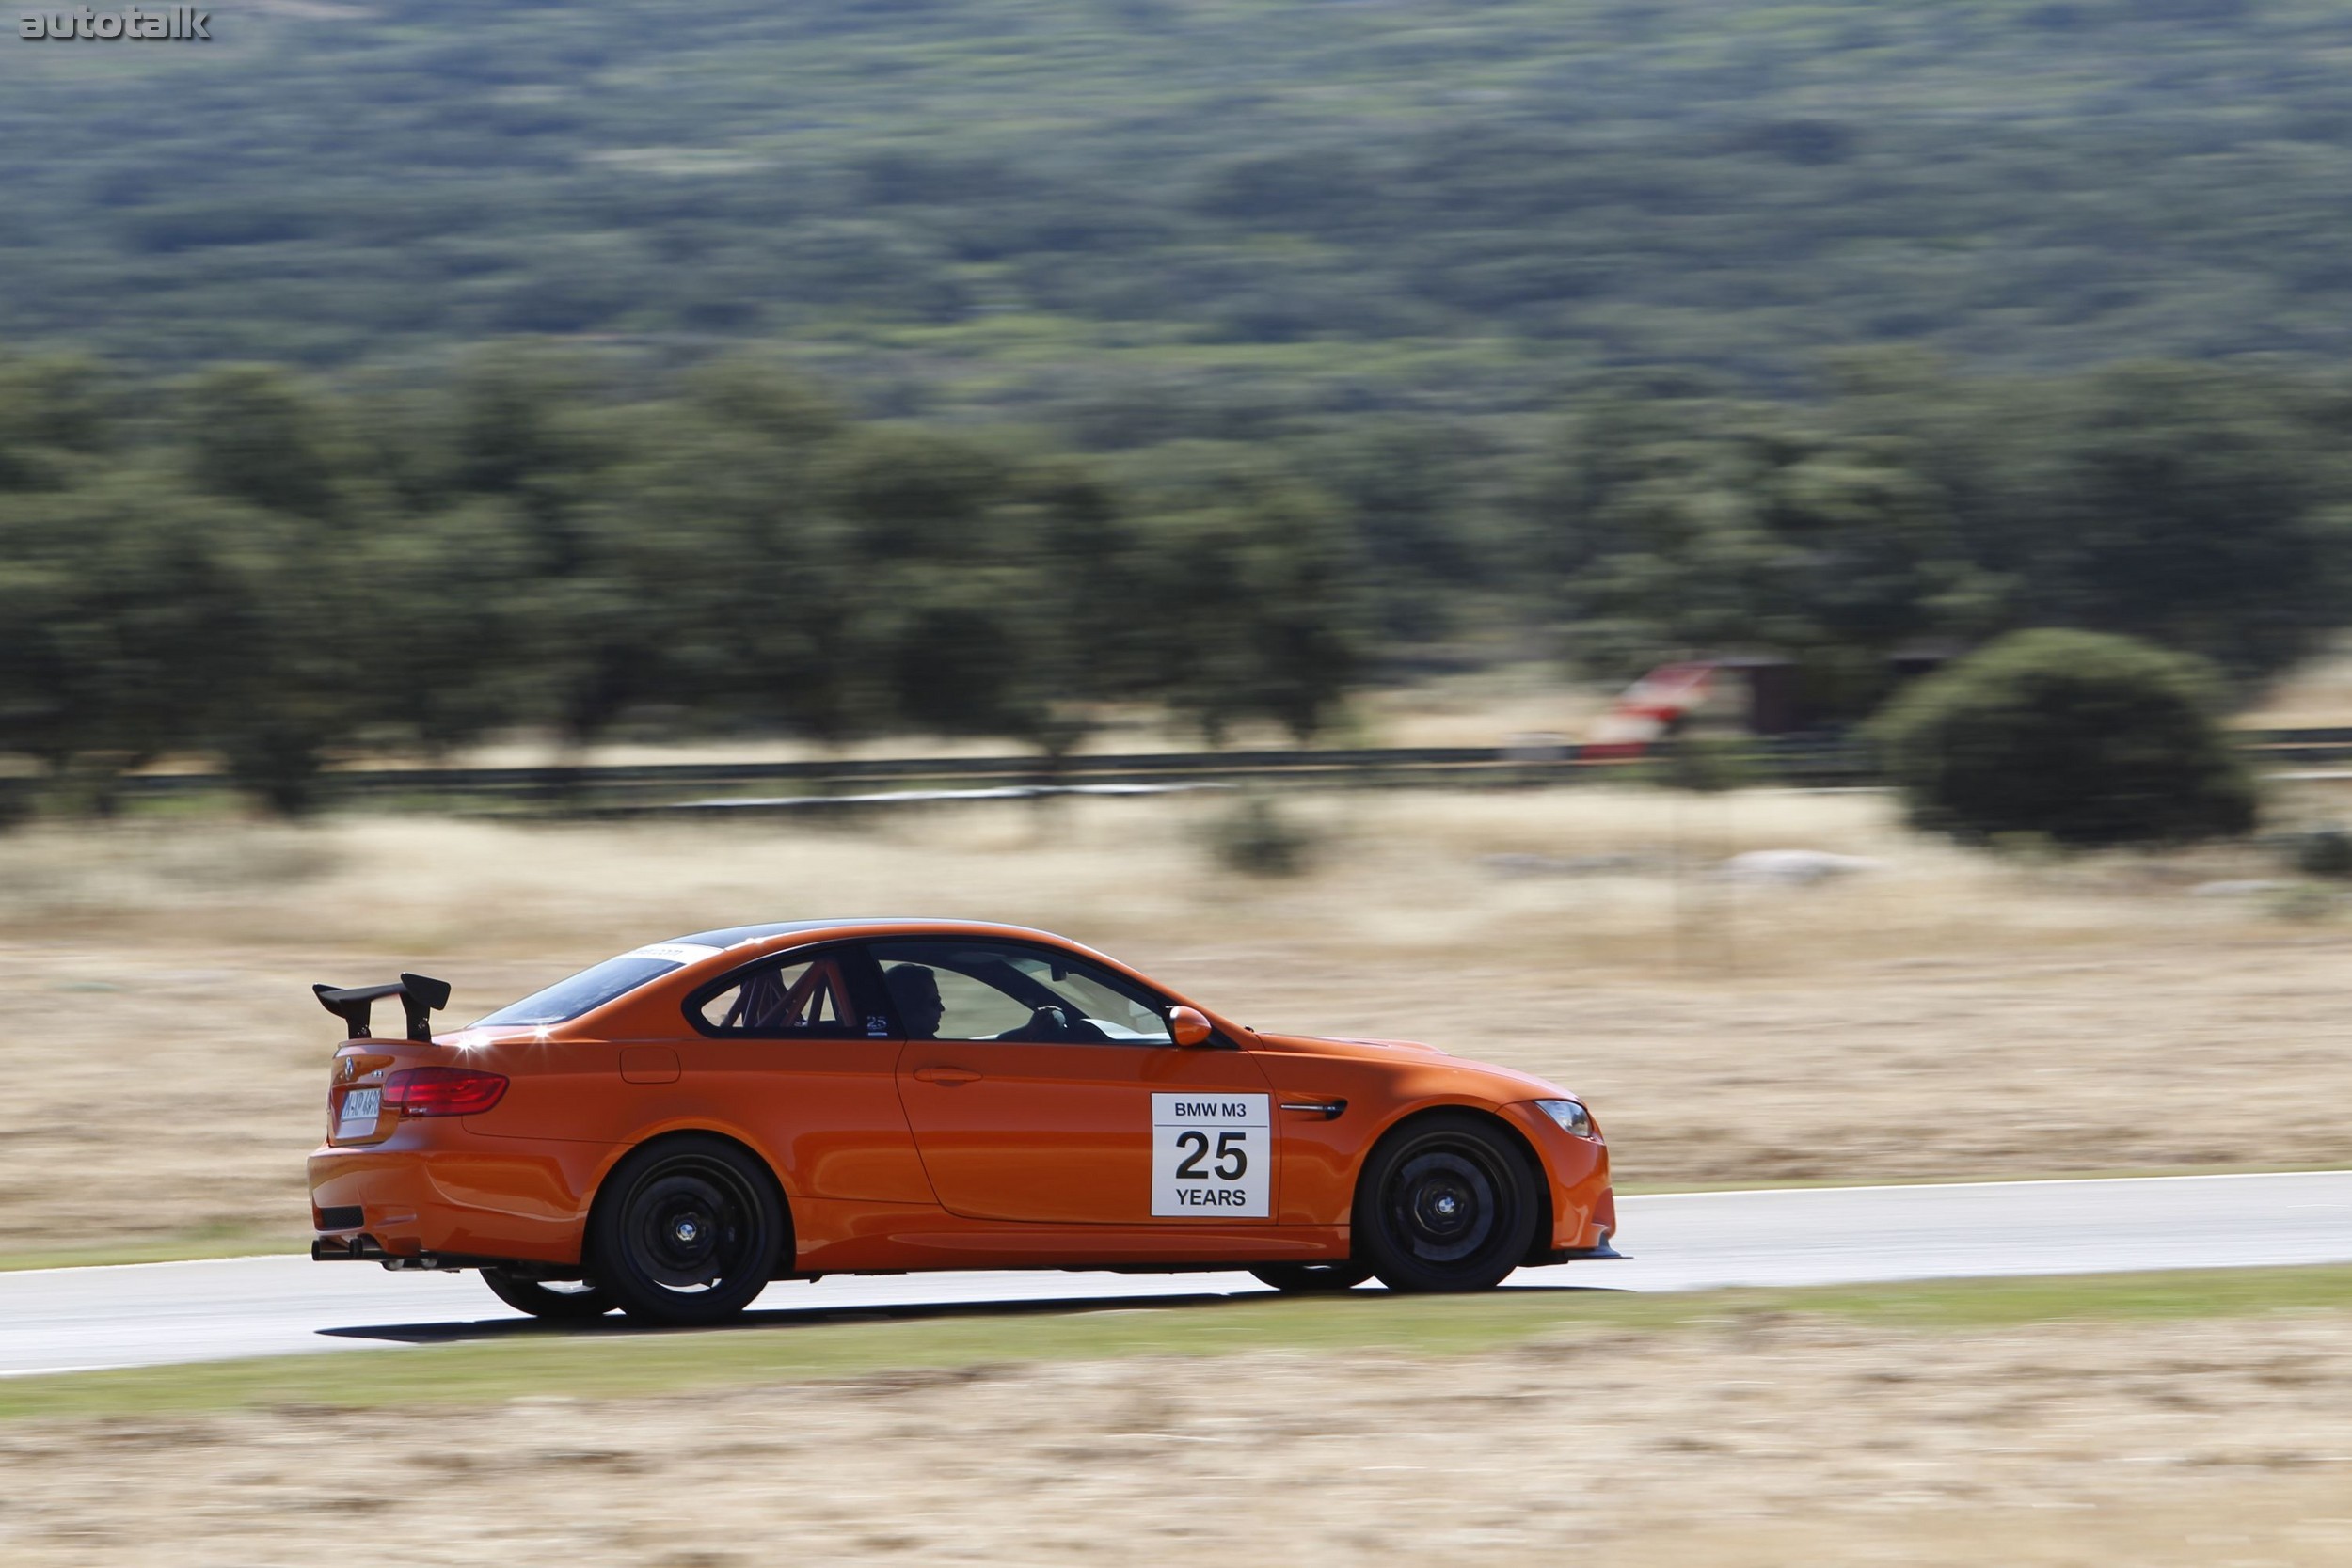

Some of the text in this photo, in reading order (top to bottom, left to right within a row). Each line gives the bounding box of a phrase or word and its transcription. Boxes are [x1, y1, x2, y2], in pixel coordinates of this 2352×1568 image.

[1175, 1102, 1247, 1117] BMW M3
[1175, 1130, 1248, 1181] 25
[1175, 1188, 1247, 1207] YEARS
